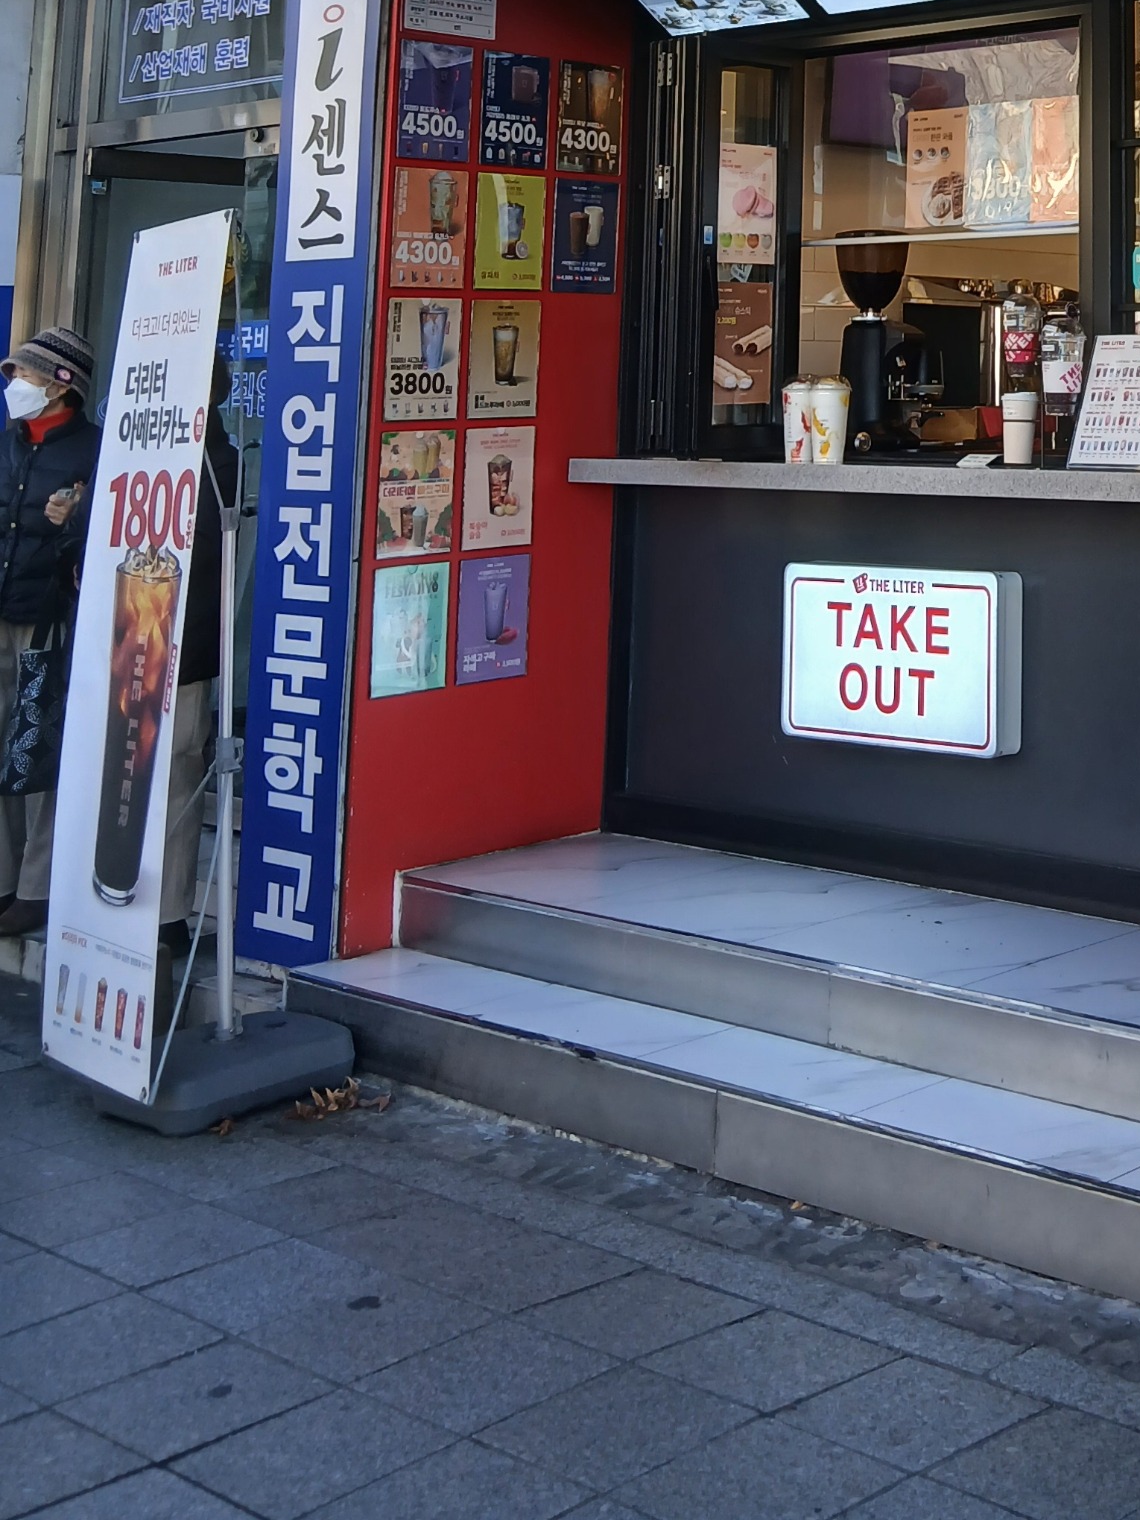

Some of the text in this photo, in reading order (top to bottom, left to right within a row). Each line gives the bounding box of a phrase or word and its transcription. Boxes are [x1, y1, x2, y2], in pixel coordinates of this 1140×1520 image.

[214, 36, 250, 72] 훈련
[159, 256, 198, 277] THE LITER
[125, 358, 168, 404] 더리터
[1060, 363, 1081, 384] THE
[119, 405, 190, 451] 아메리카노
[869, 579, 925, 594] THE LITER
[252, 283, 346, 943] 직업전문학교
[827, 601, 950, 655] TAKE
[839, 662, 935, 717] OUT
[117, 718, 139, 828] LITER
